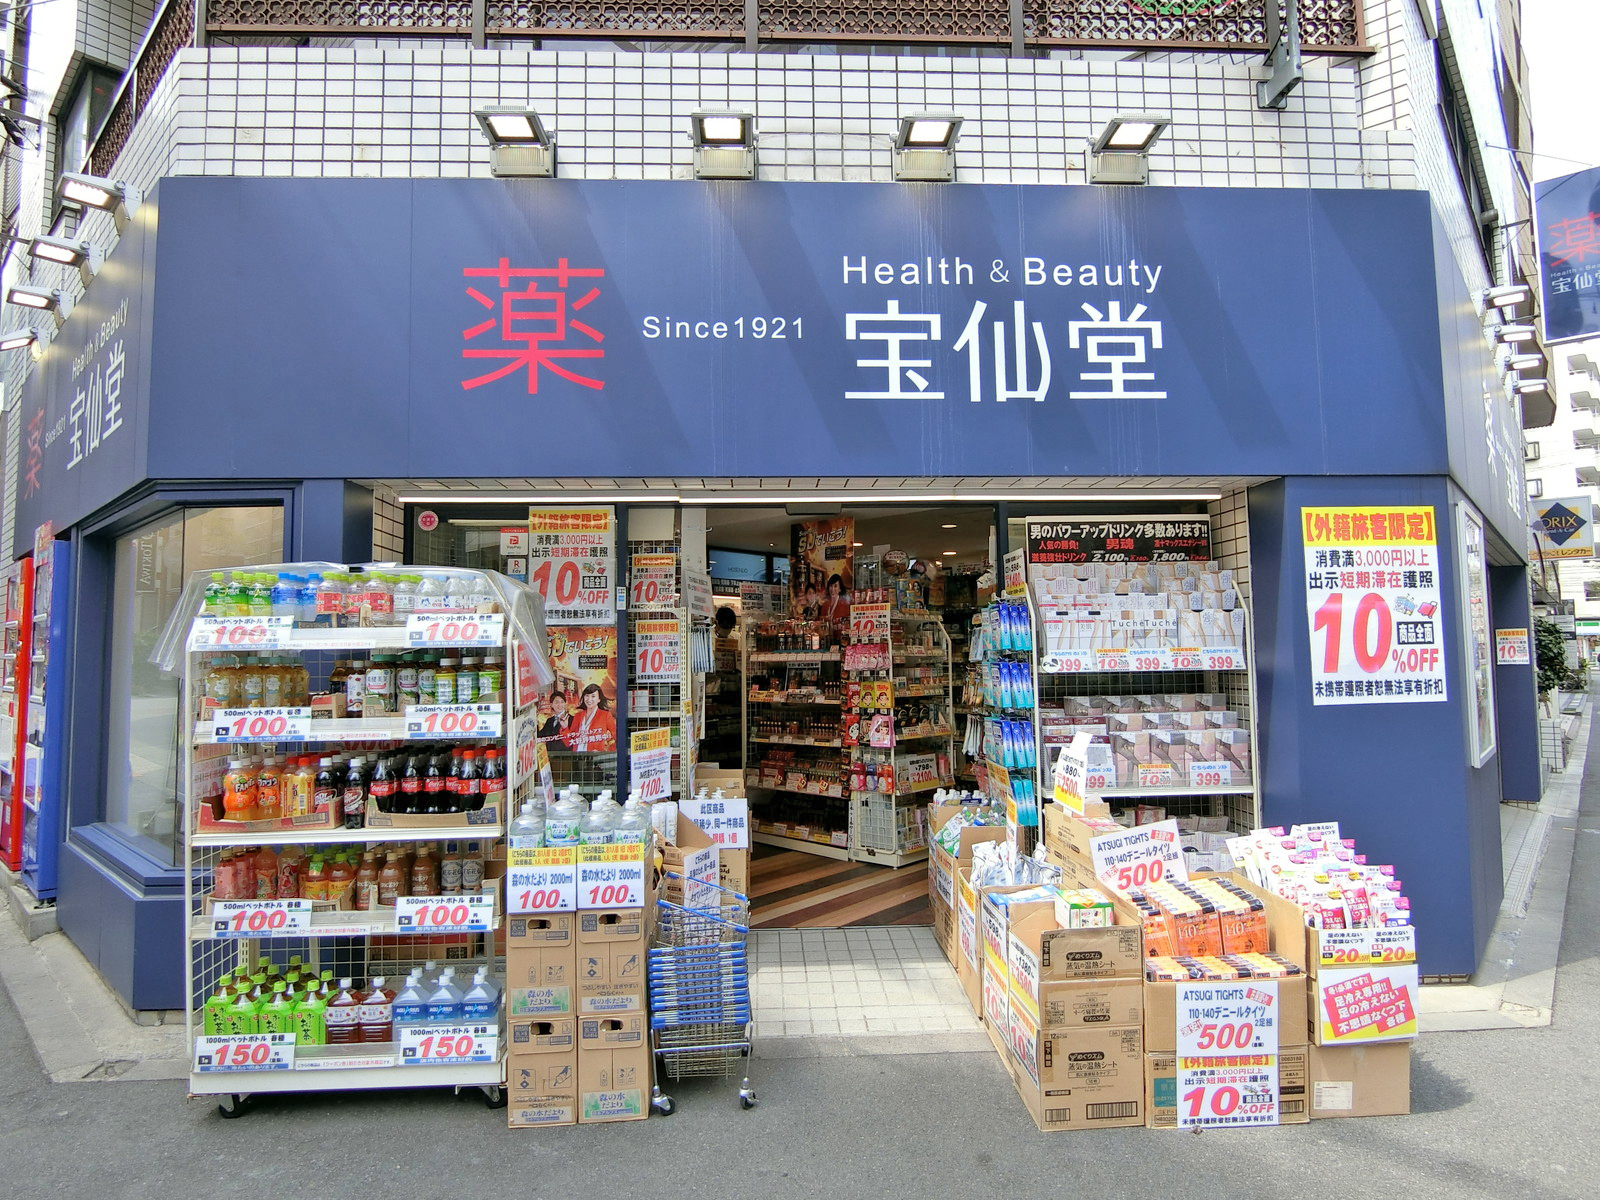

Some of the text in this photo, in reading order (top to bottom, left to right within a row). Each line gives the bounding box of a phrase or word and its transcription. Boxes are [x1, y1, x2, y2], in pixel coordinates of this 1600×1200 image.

[1548, 212, 1600, 267] 薬
[842, 256, 1164, 293] Health & Beauty
[100, 297, 129, 349] Beauty
[462, 257, 606, 394] 薬
[844, 300, 1168, 402] 宝仙堂
[67, 339, 126, 471] 宝仙堂
[1106, 538, 1135, 550] 男魂
[532, 560, 581, 606] 10
[633, 580, 659, 603] 10
[425, 622, 479, 641] 100
[1112, 619, 1145, 628] Tuché
[1144, 619, 1177, 628] Tuché
[1313, 592, 1439, 674] 10 %OFF
[638, 648, 664, 673] 10
[1058, 658, 1082, 671] 399
[1135, 657, 1160, 670] 399
[1208, 656, 1233, 669] 399
[232, 716, 287, 737] 100
[424, 712, 478, 732] 100
[1195, 772, 1221, 786] 399
[690, 817, 745, 830] 稀少,同一件商品
[1097, 832, 1150, 853] ATSUGI TIGHTS
[512, 872, 573, 887] 森の水だより 2000ml
[581, 868, 641, 882] 森の水だより 2000ml
[1117, 859, 1163, 890] 500
[519, 889, 560, 909] 100
[589, 884, 629, 905] 100
[232, 909, 287, 931] 100
[415, 905, 469, 926] 100
[1334, 948, 1359, 962] 20
[1382, 946, 1406, 961] 20
[527, 989, 554, 999] 森の水
[589, 996, 633, 1006] 森の水だより
[1183, 989, 1244, 1001] ATSUGI TIGHTS
[1337, 990, 1400, 1019] 足の冷えない
[1337, 1000, 1407, 1033] 不思議なくつ下
[419, 1035, 474, 1057] 150
[1197, 1022, 1254, 1049] 500
[214, 1043, 271, 1066] 150
[600, 1092, 626, 1102] 森の水
[1183, 1085, 1275, 1117] 10 %OFF
[521, 1109, 566, 1118] 森の水だより
